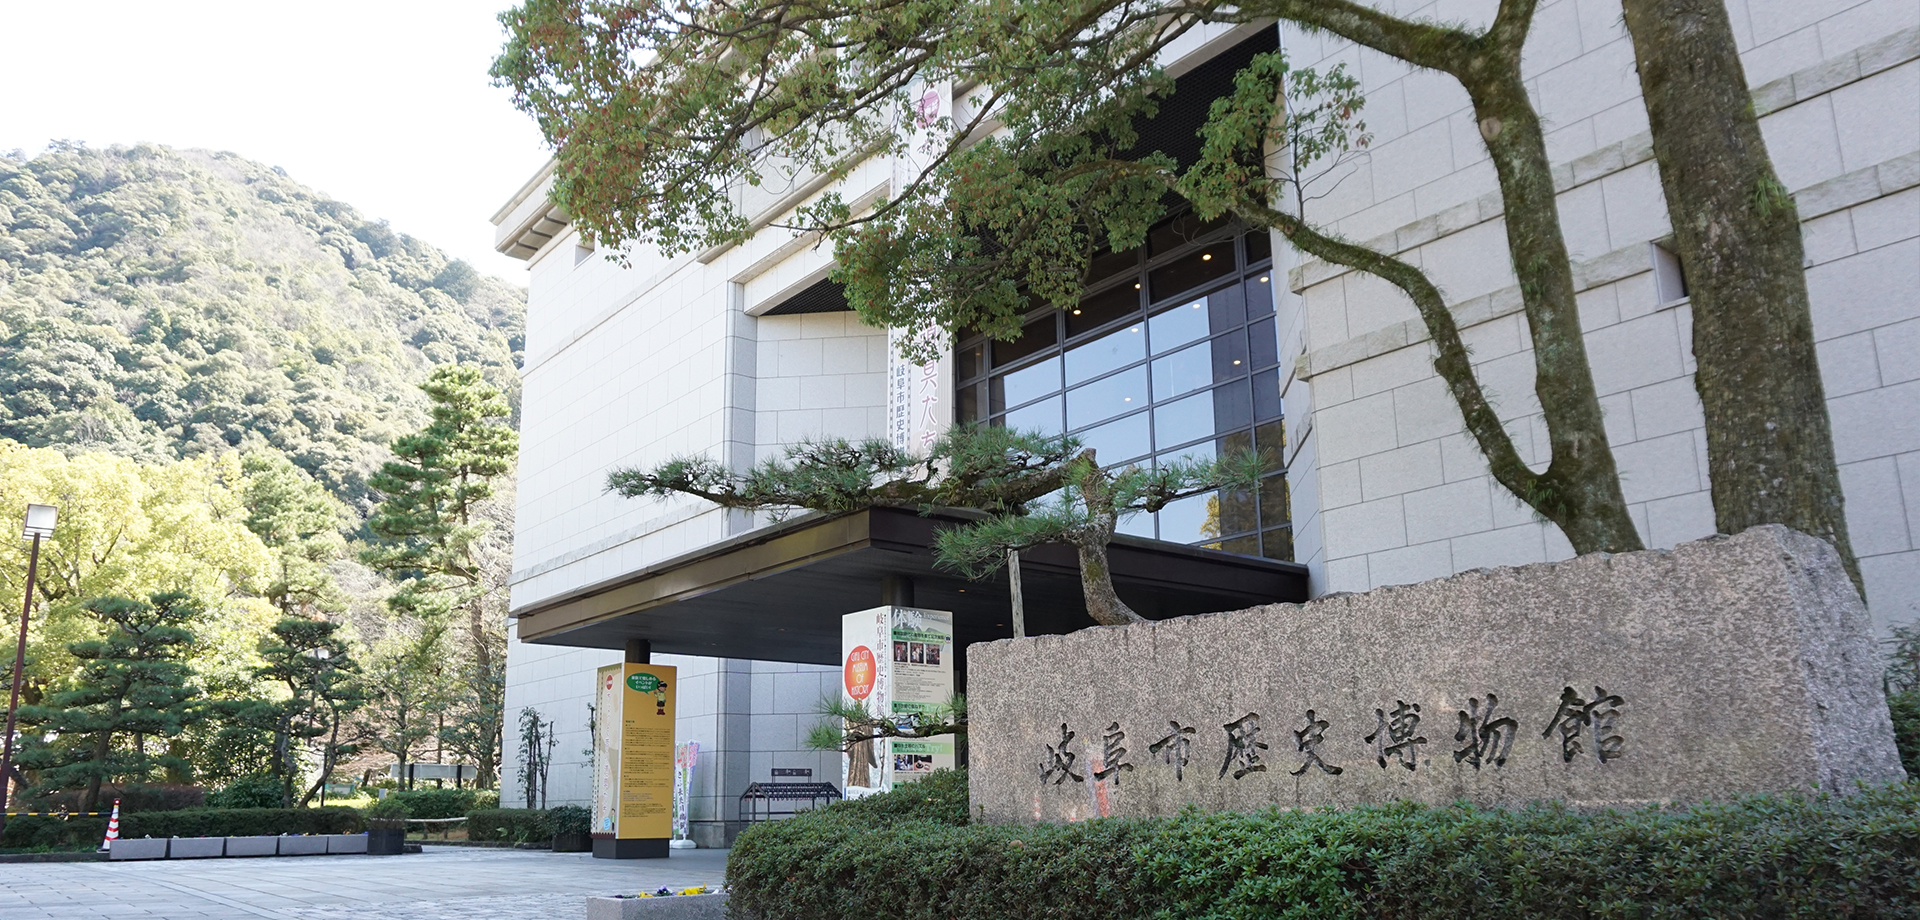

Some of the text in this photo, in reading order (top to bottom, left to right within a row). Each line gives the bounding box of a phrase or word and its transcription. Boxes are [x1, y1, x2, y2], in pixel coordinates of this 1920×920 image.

[892, 607, 922, 630] 体験
[922, 611, 950, 621] Experience
[850, 649, 870, 662] GIFU CITY
[851, 662, 869, 673] MUSEUM
[876, 611, 885, 717] 岐阜市歴史博物館
[855, 673, 865, 685] OF
[851, 684, 870, 697] HISTORY
[1038, 685, 1626, 787] 岐阜市歴史博物館
